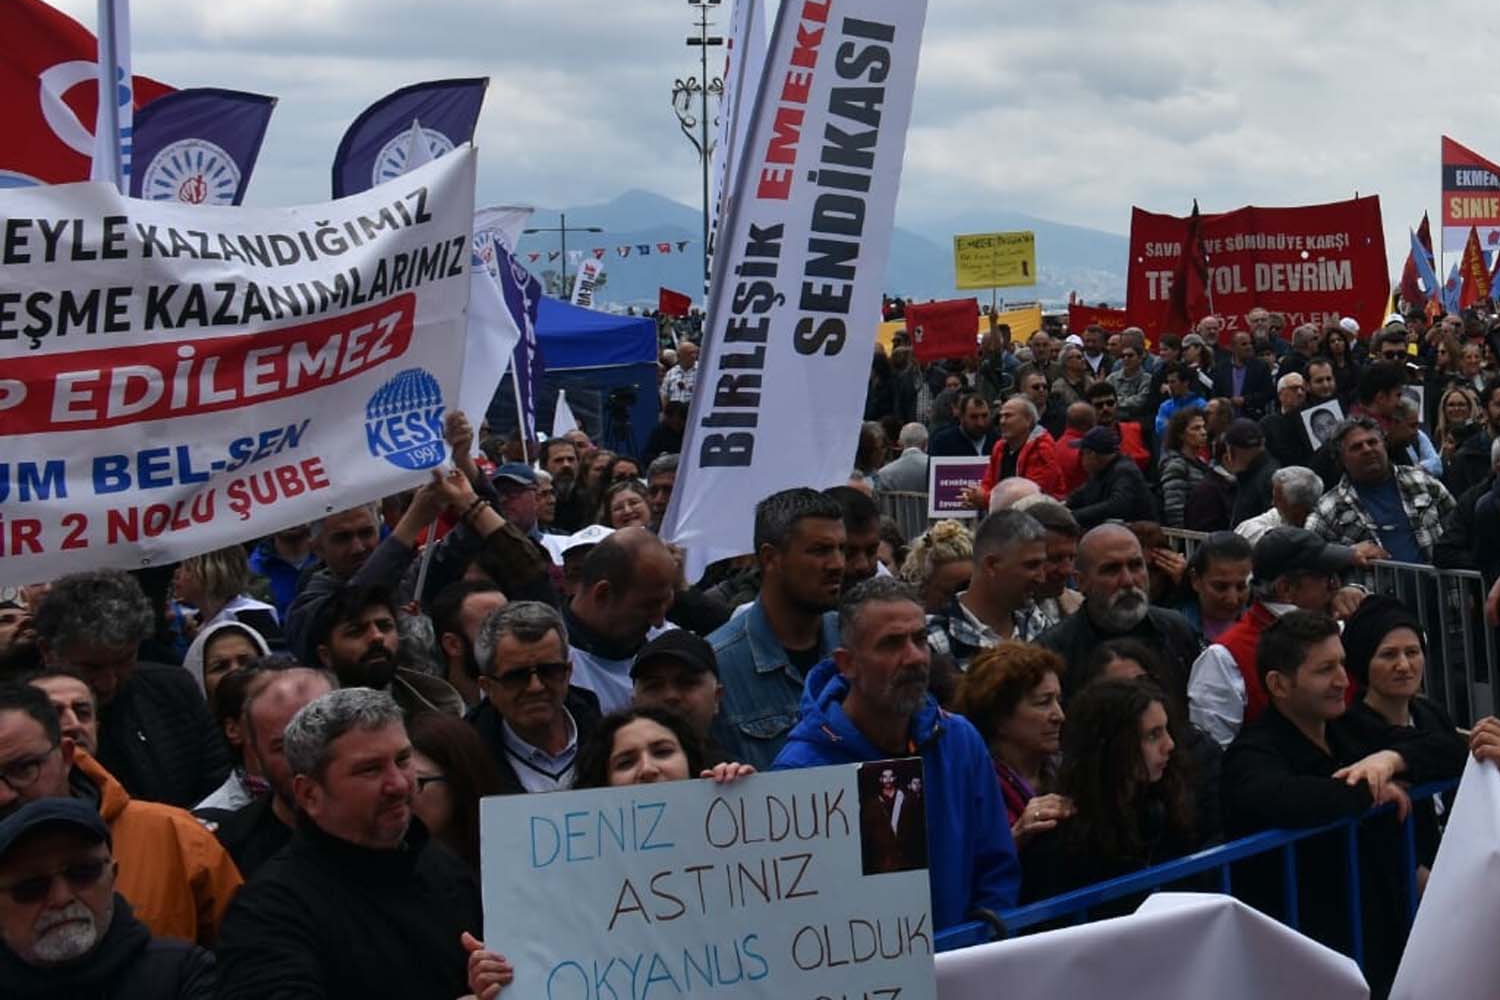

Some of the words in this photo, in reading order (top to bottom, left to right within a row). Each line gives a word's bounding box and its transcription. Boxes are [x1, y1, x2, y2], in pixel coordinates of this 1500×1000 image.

[794, 17, 896, 357] SENDİKASI
[1450, 197, 1500, 219] SINIF
[3, 216, 128, 264] EYLE
[136, 187, 431, 268] KAZANDIĞIMIZ
[1145, 241, 1182, 257] SAVA
[1306, 232, 1349, 251] KARŞI
[0, 287, 132, 349] EŞME
[144, 236, 466, 331] KAZANIMLARIMIZ
[1254, 256, 1353, 292] DEVRİM
[51, 311, 402, 423] EDİLEMEZ
[700, 222, 785, 468] BİRLEŞİK
[92, 418, 311, 495] BEL-SEN
[365, 406, 447, 457] KESK
[61, 513, 88, 550] 2
[107, 488, 216, 545] NOLU
[227, 457, 330, 521] ŞUBE
[530, 800, 675, 868] DENİZ
[705, 789, 851, 849] OLDUK
[608, 853, 819, 931] ASTINIZ
[547, 934, 770, 1000] OKYANUS
[792, 914, 931, 971] OLDUK
